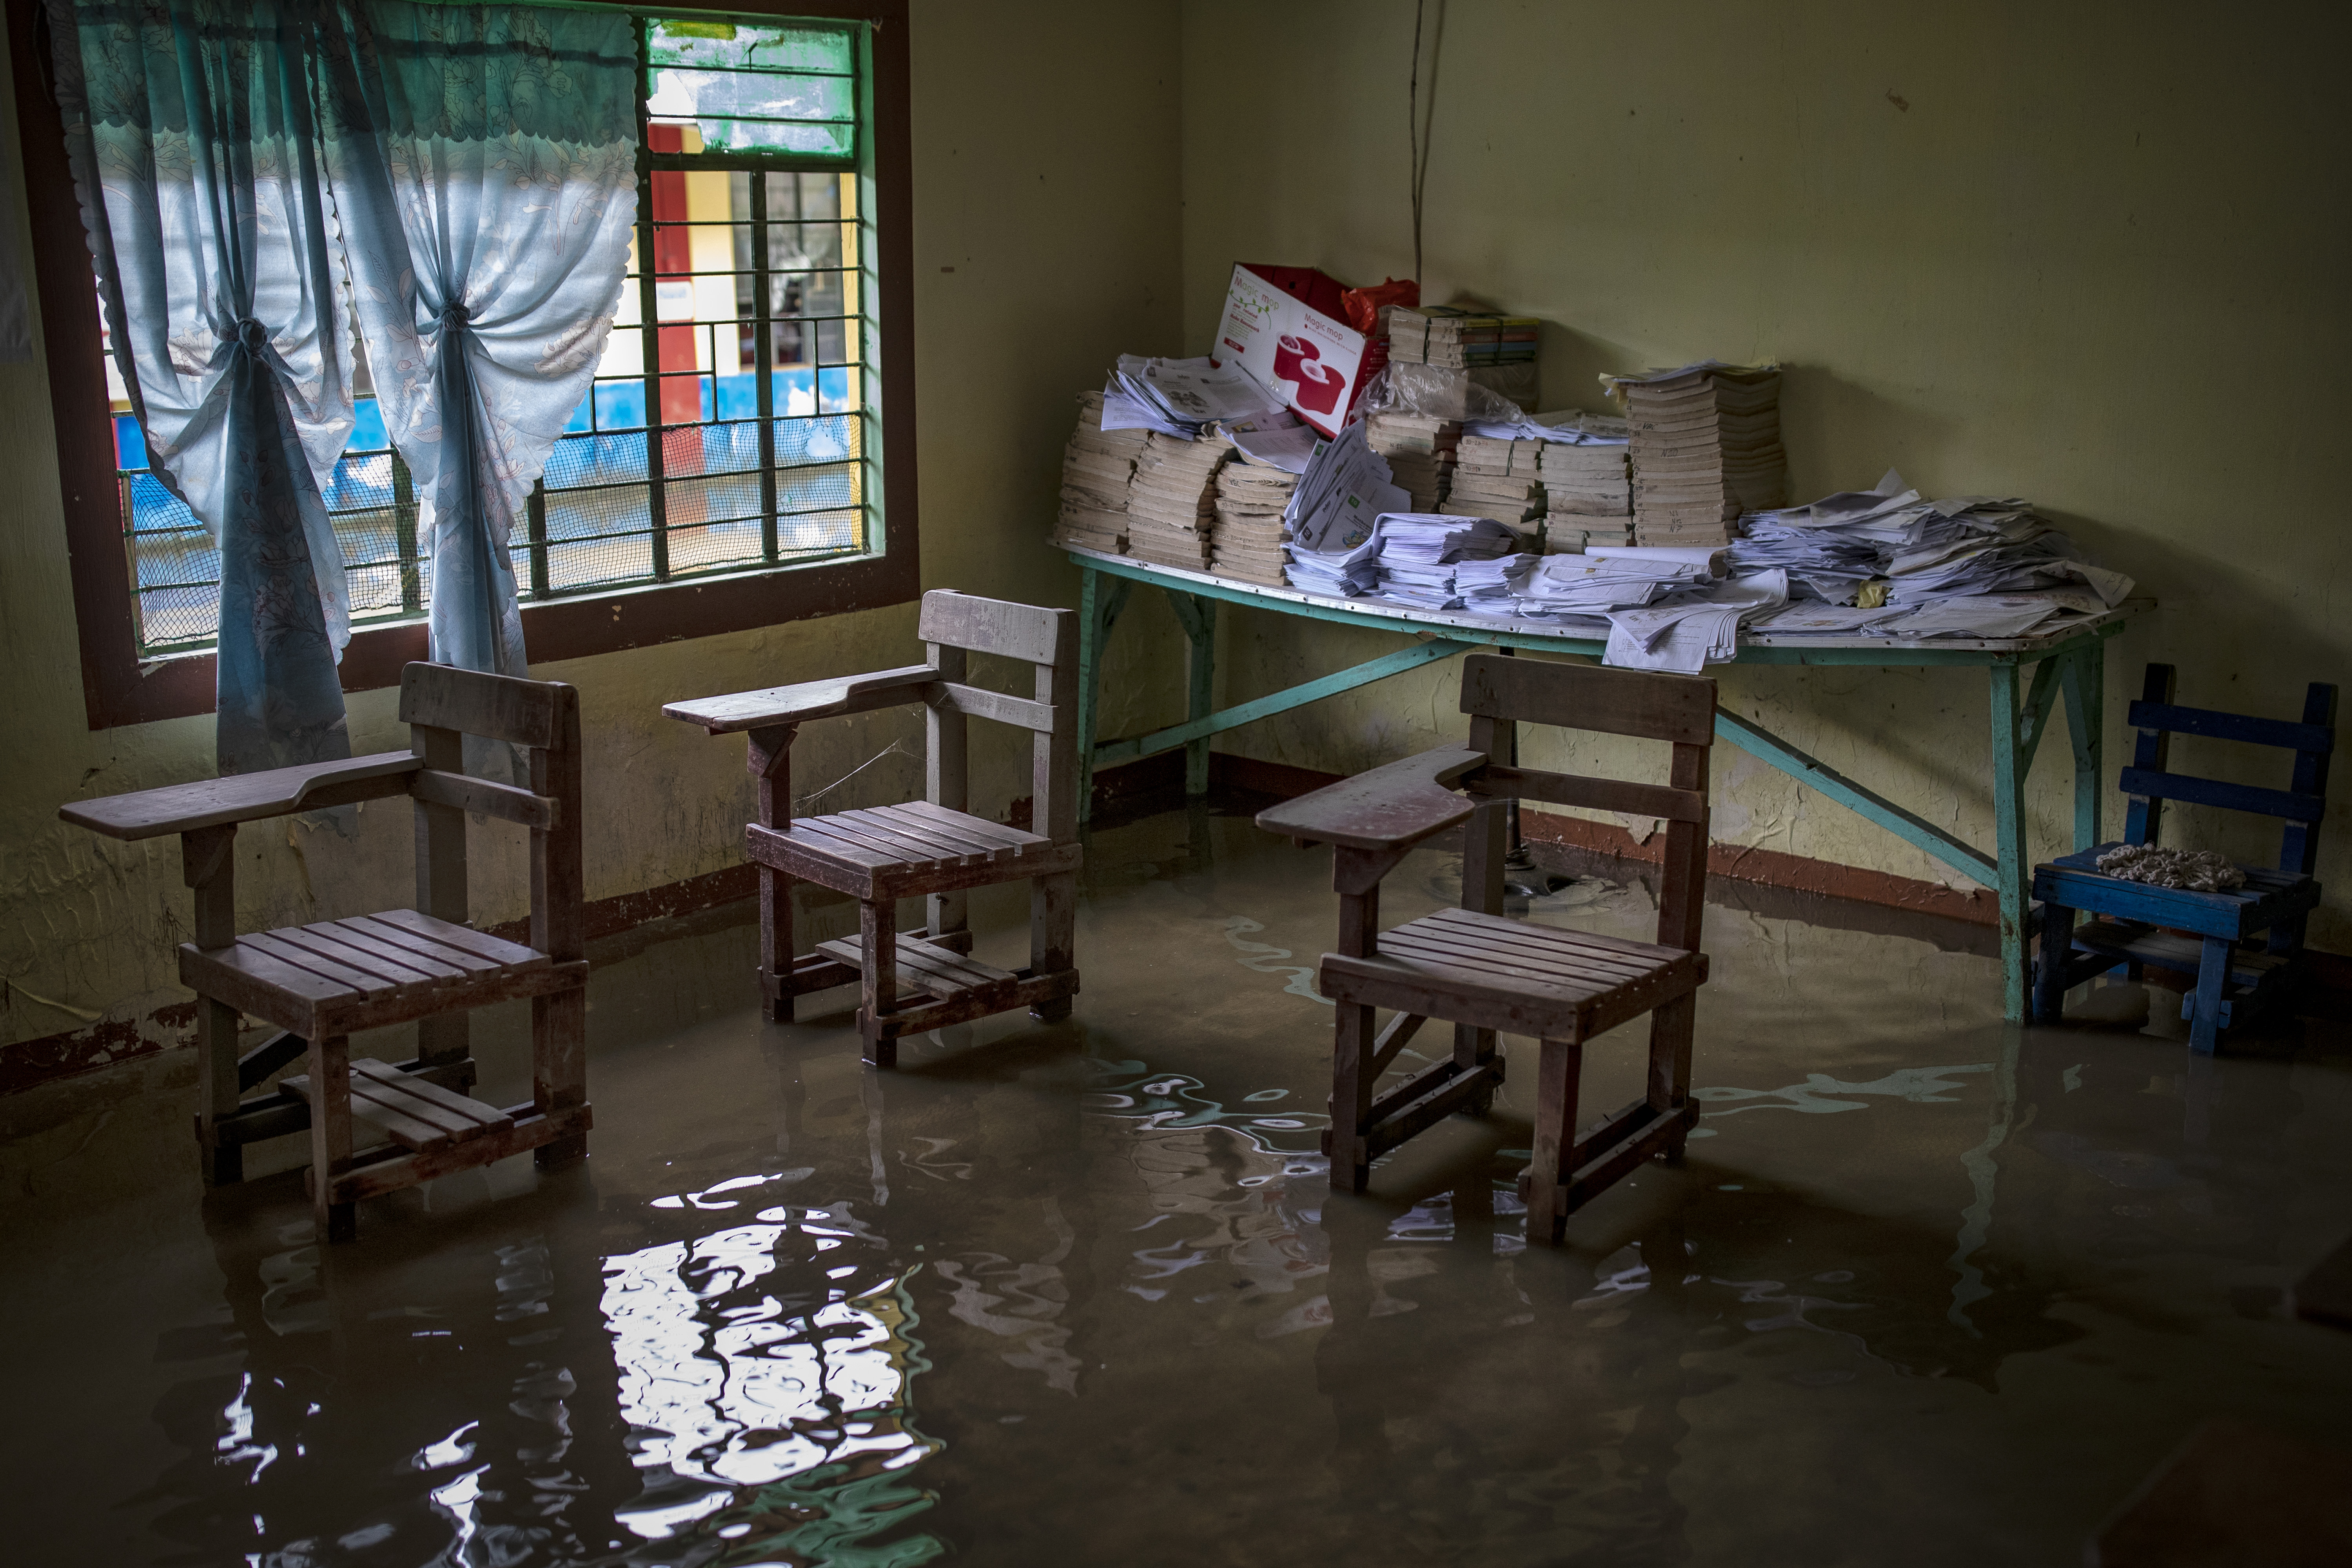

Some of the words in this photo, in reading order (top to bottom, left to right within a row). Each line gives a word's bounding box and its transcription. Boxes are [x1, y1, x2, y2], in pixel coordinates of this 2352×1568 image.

[1234, 276, 1258, 298] Magic
[1261, 294, 1279, 310] mop
[1304, 313, 1326, 331] Magic
[1327, 327, 1343, 341] mop
[1353, 514, 1373, 530] Mathema
